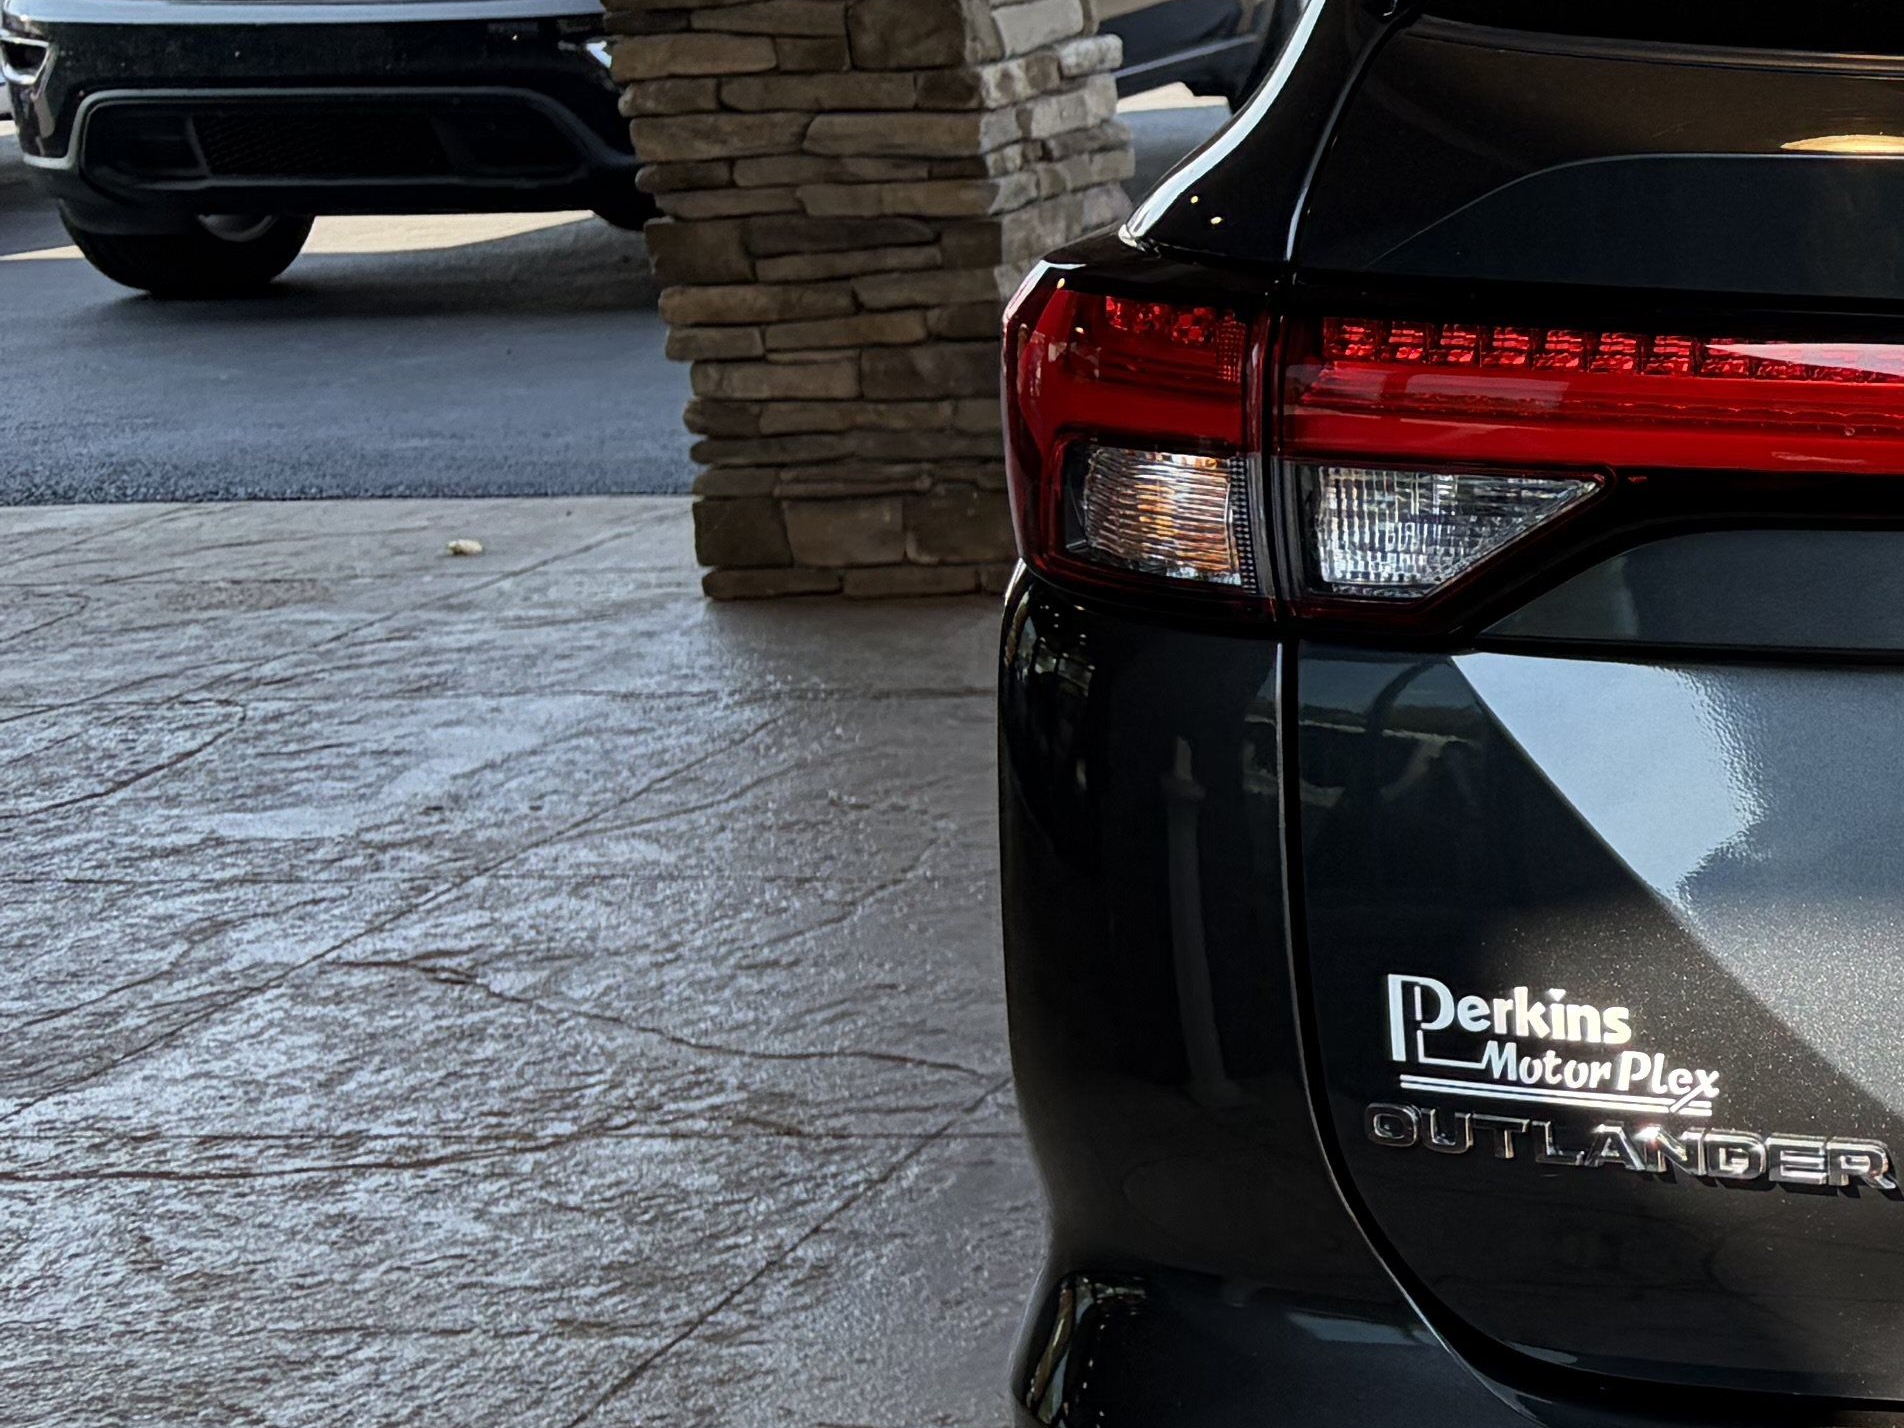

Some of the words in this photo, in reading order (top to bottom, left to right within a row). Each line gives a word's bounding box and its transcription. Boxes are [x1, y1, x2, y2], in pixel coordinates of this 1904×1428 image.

[1387, 973, 1633, 1061] Perkins
[1480, 1040, 1613, 1090] Motor
[1616, 1050, 1721, 1113] Plex
[1365, 1102, 1899, 1190] OUTLANDER
